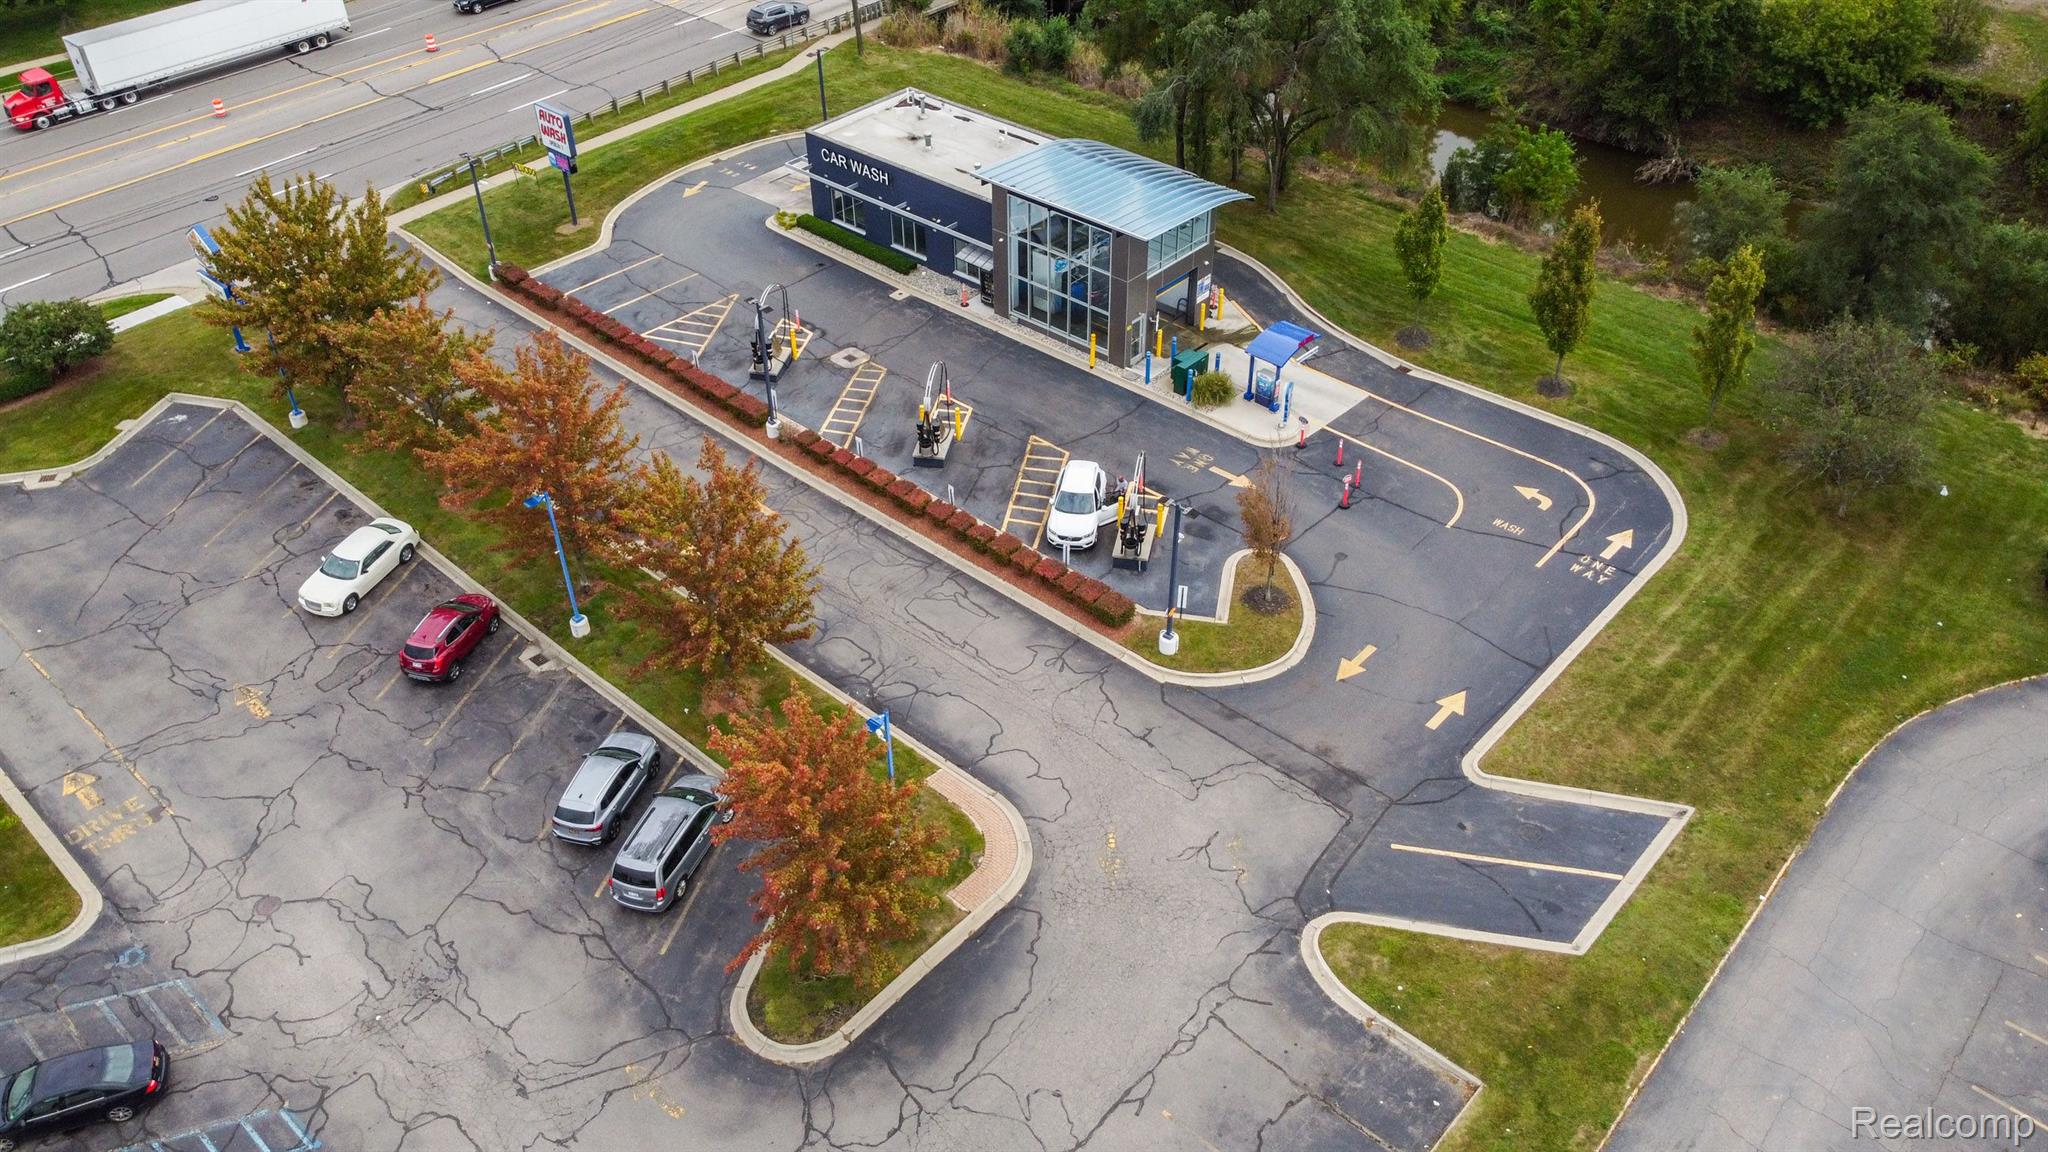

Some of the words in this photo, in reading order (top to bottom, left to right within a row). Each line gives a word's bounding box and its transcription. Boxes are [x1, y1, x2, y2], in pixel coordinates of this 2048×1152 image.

[538, 109, 563, 129] AUTO
[541, 124, 566, 144] WASH
[821, 148, 848, 170] CAR
[850, 158, 889, 186] WASH
[1492, 518, 1525, 536] WASH
[1569, 563, 1612, 585] WAY
[1580, 555, 1617, 575] ONE
